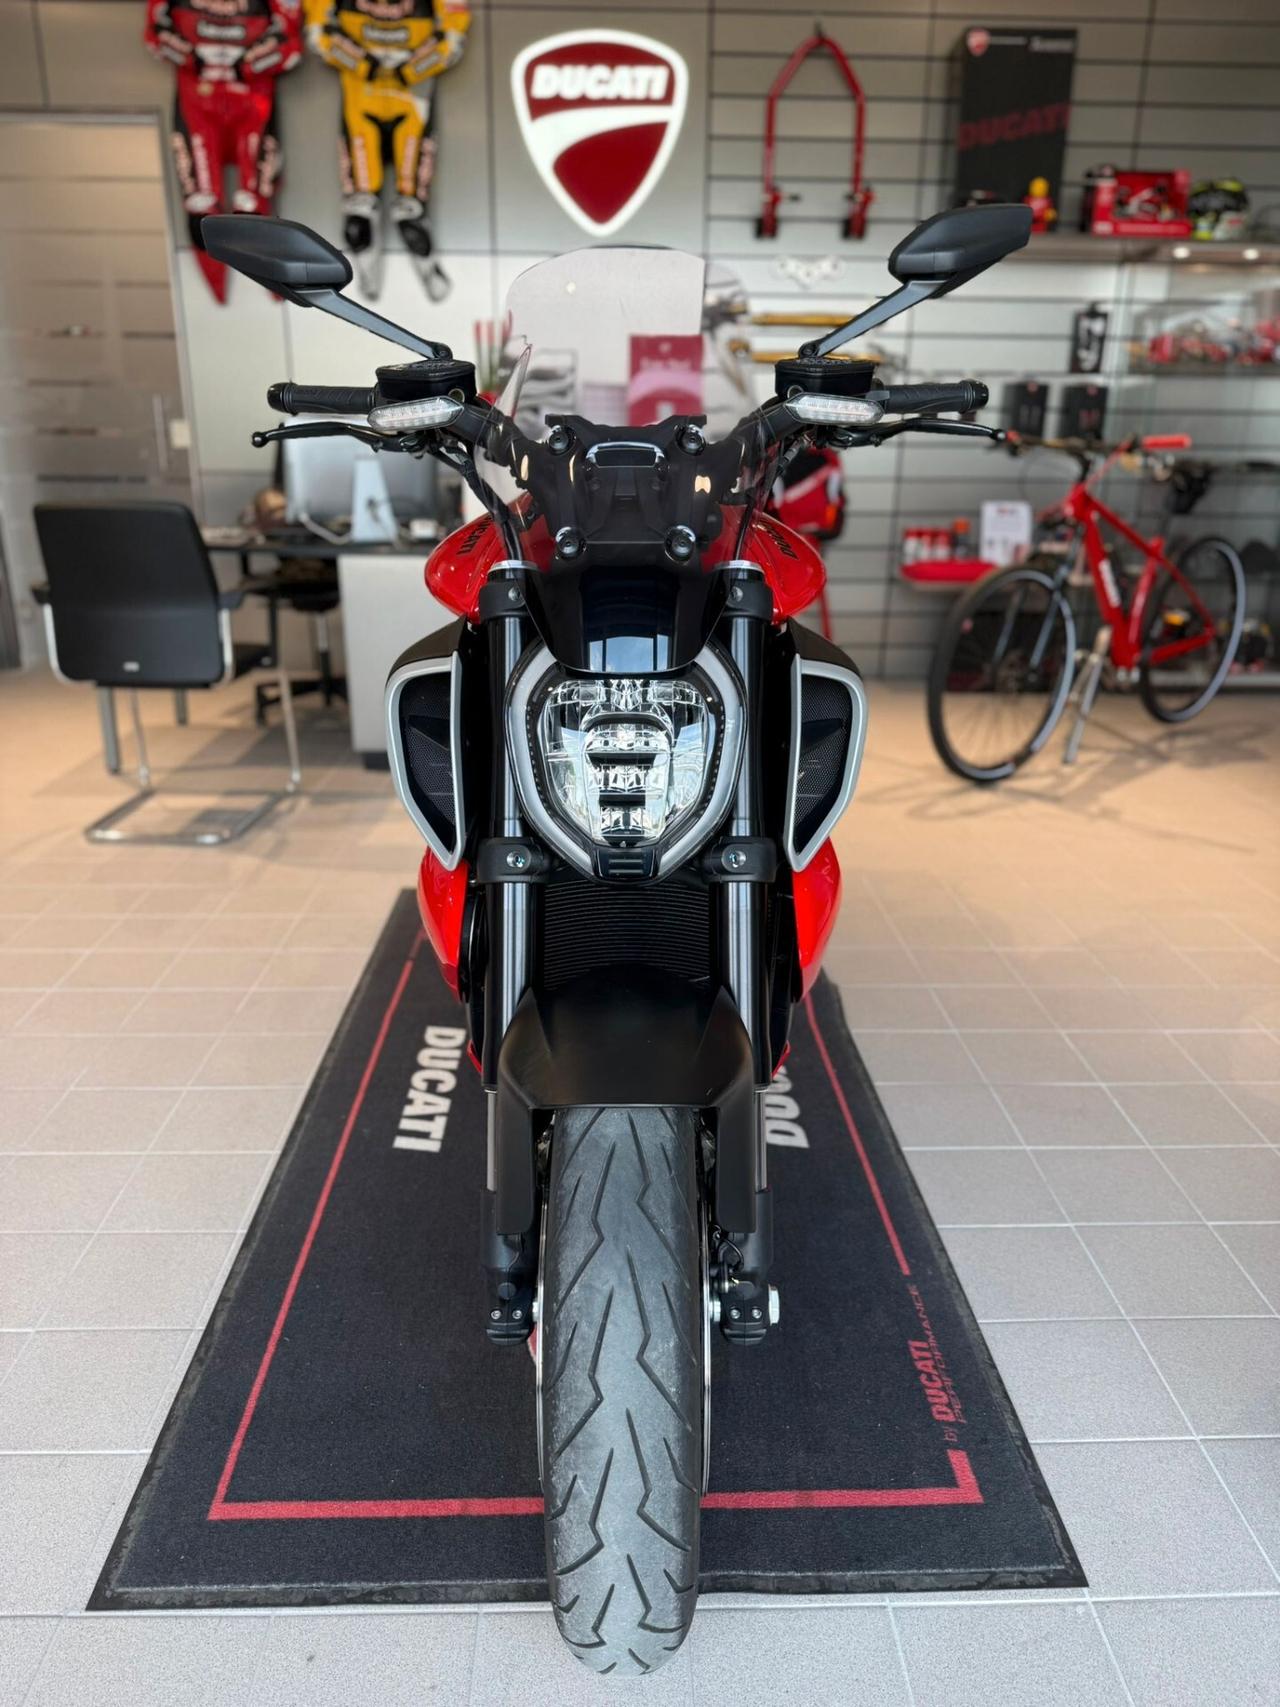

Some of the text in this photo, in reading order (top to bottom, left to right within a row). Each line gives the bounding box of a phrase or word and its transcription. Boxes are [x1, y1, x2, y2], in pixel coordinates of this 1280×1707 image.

[530, 64, 669, 100] DUCATI
[393, 1025, 467, 1153] DUCATI
[908, 1340, 956, 1422] DUCATI
